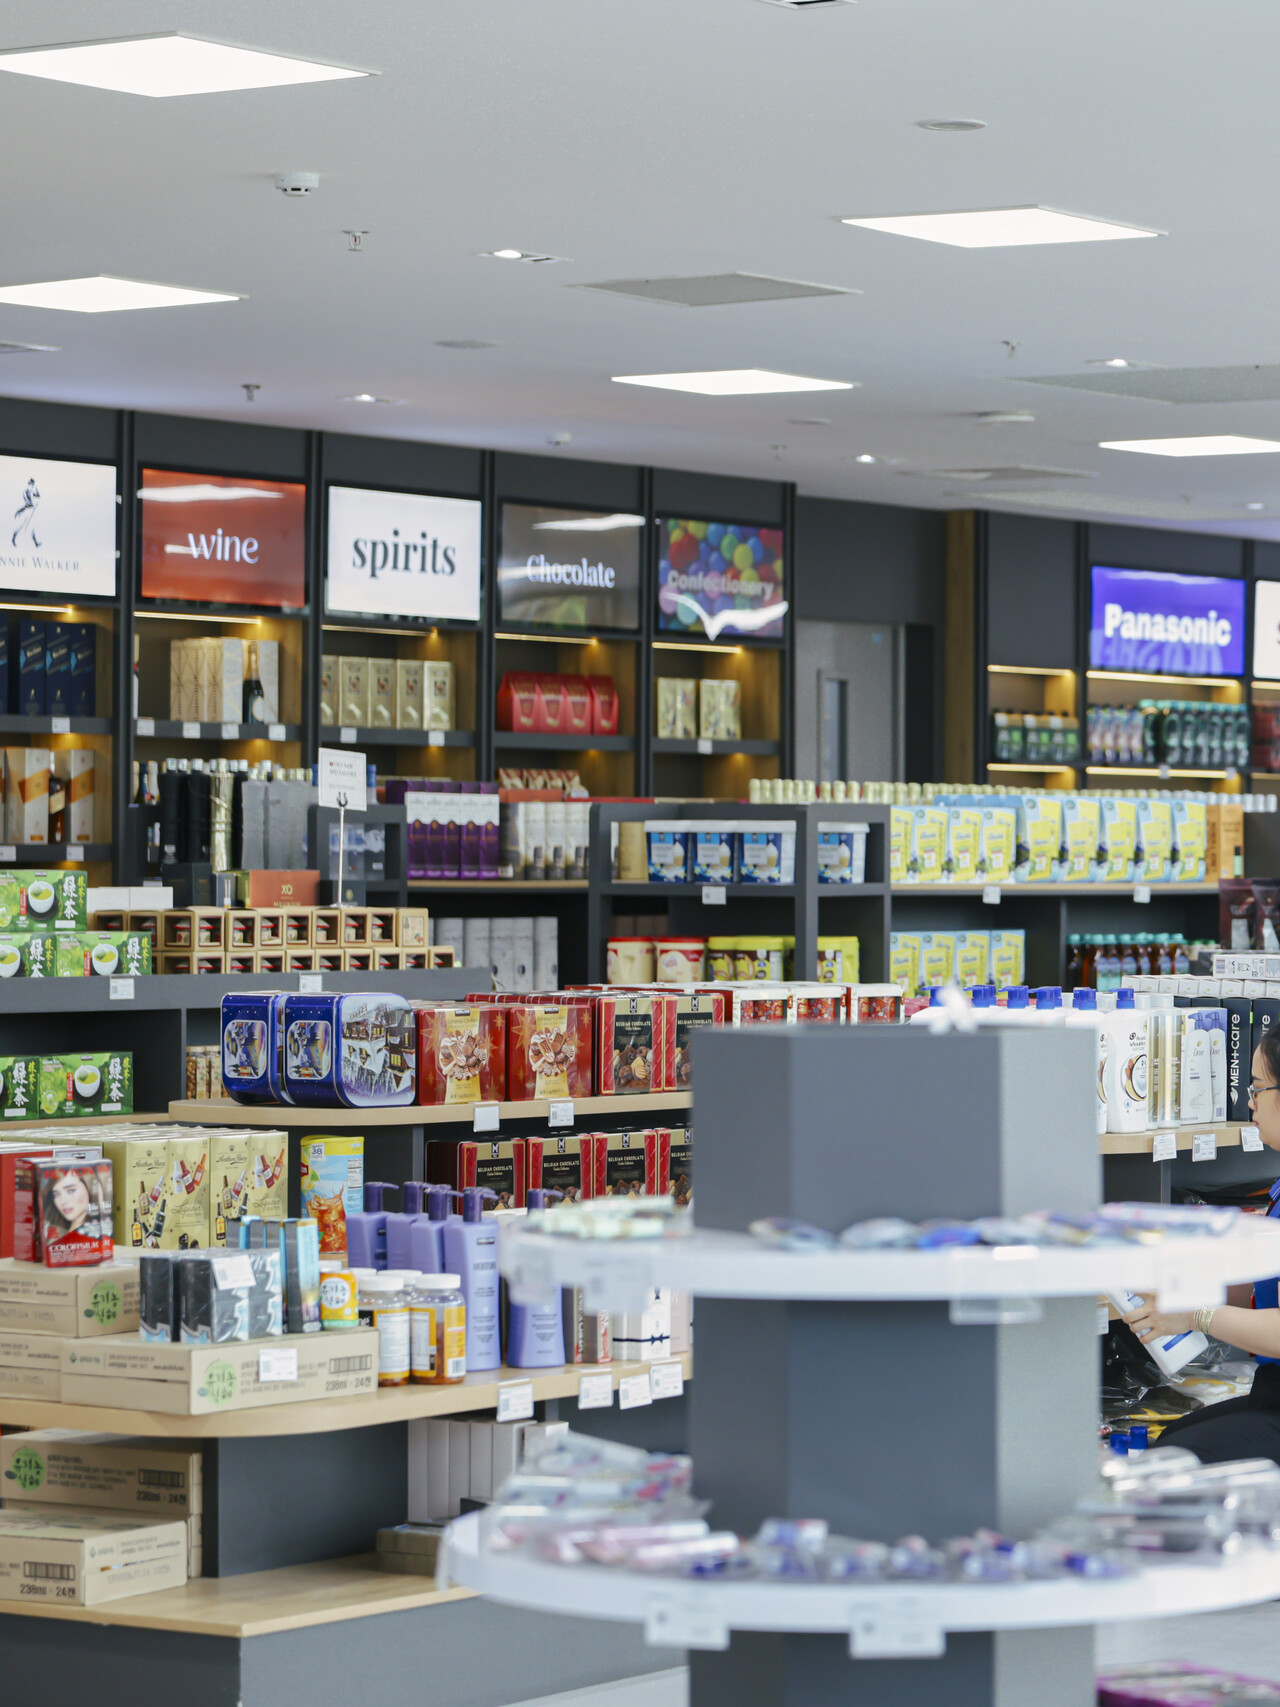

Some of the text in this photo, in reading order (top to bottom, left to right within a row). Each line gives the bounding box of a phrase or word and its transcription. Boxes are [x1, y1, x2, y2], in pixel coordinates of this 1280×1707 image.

[187, 528, 259, 564] wine
[352, 528, 456, 579] spirits
[32, 556, 80, 572] WALKER
[526, 554, 615, 588] Chocolate
[667, 569, 774, 602] Confectionery
[1104, 603, 1231, 646] Panasonic
[281, 884, 293, 895] XO
[1230, 1014, 1240, 1087] MEN+care
[311, 1147, 323, 1155] 38
[49, 1242, 100, 1252] COLORSILK
[326, 1379, 348, 1392] 238ml
[20, 1583, 47, 1595] 238ml
